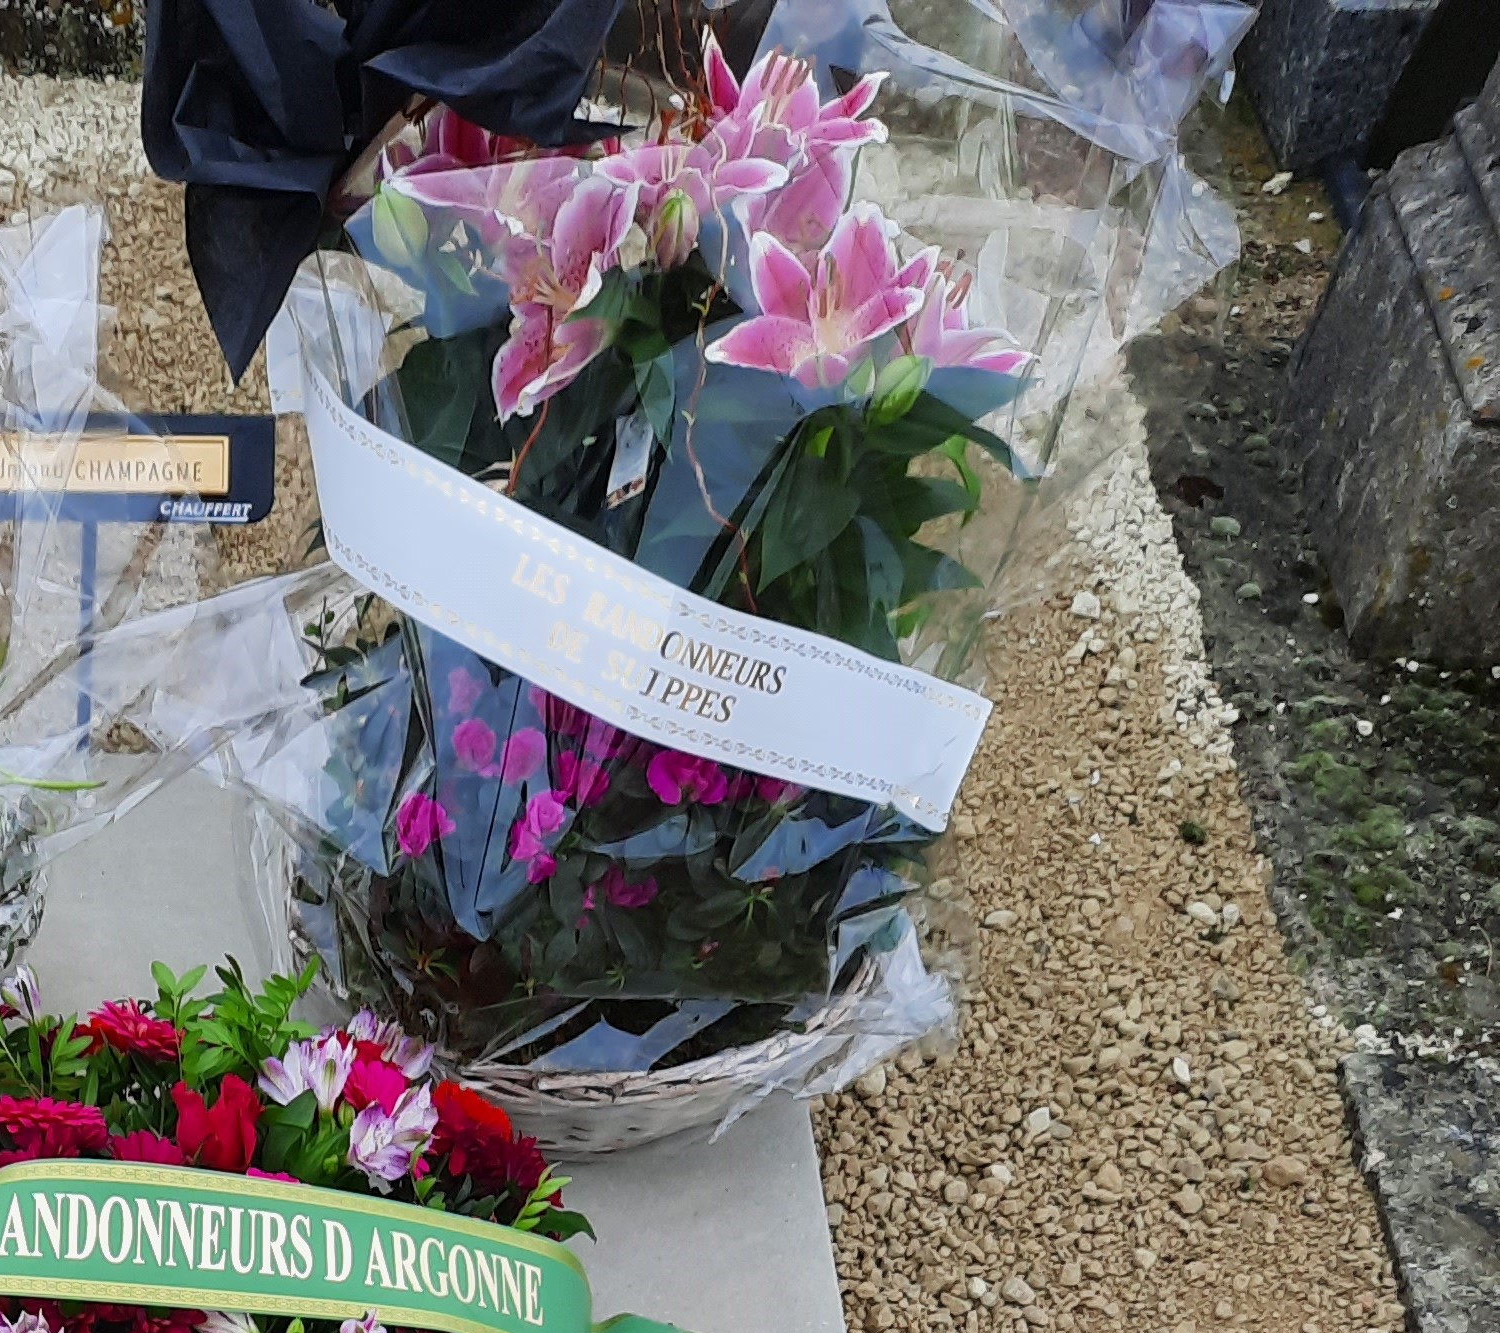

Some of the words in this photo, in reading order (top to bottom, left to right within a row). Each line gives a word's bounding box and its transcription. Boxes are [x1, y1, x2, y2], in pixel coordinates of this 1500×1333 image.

[74, 459, 202, 483] CHAMPAGNE
[160, 500, 253, 519] CHAUFFERT
[511, 553, 570, 606] LES
[582, 590, 787, 696] RANDONNEURS
[548, 620, 591, 665] DE
[601, 650, 737, 724] SUIPPES
[322, 1218, 353, 1284] D
[363, 1226, 544, 1327] ARGONNE
